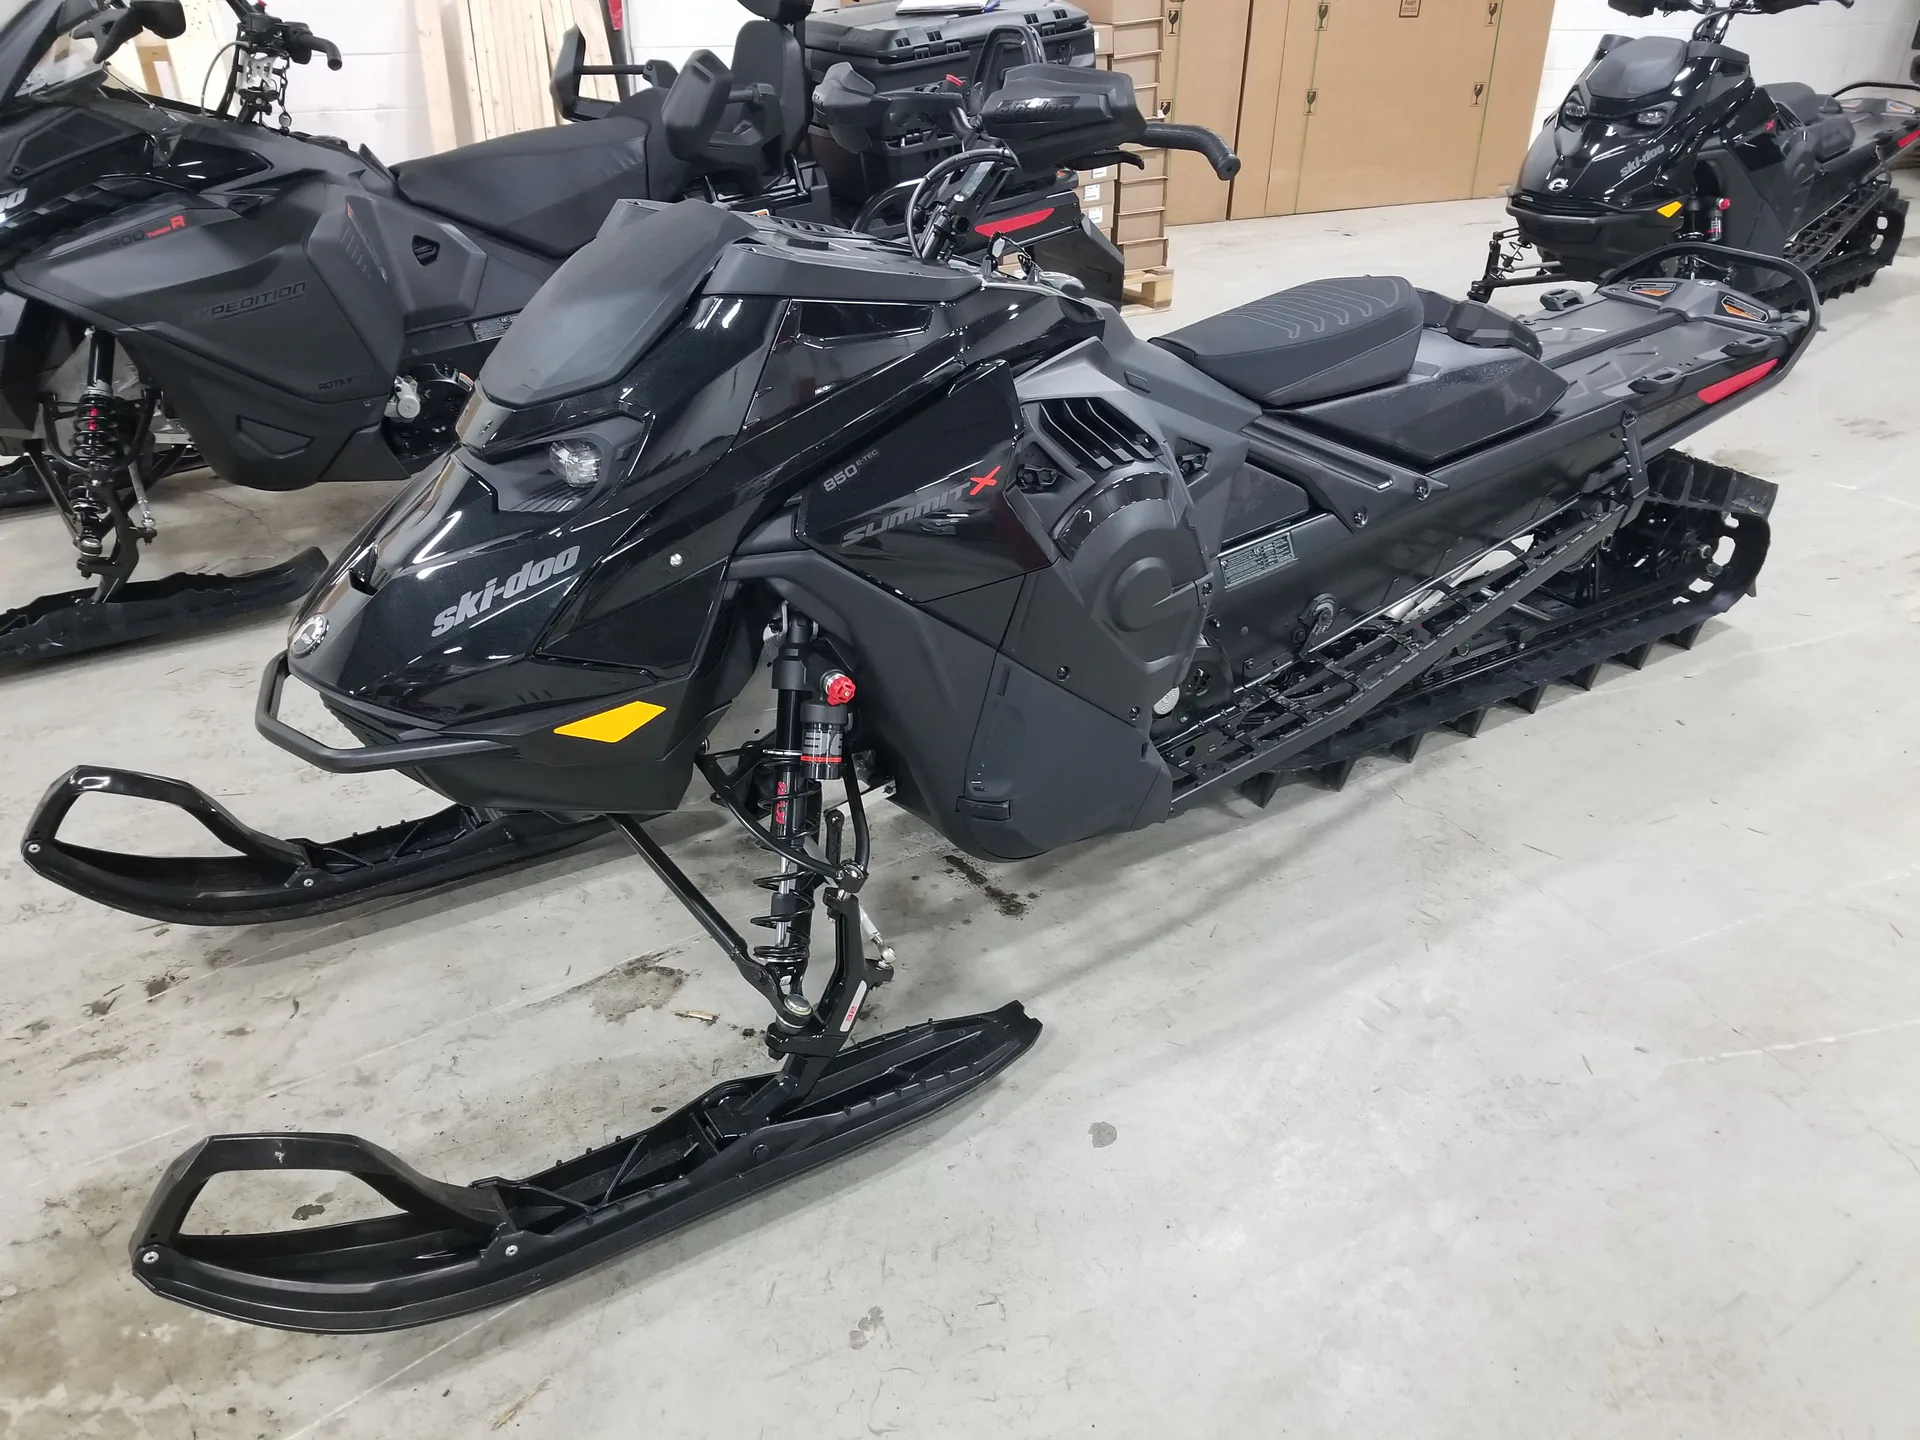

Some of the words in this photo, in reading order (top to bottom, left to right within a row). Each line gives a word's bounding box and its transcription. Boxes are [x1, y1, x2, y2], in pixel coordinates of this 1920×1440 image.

[1620, 144, 1665, 178] ski-doo
[170, 215, 186, 230] R
[823, 464, 858, 493] 850
[855, 449, 879, 467] E-TEC
[840, 481, 972, 548] SUMMIT
[969, 465, 1001, 496] X
[431, 545, 581, 638] ski-doo
